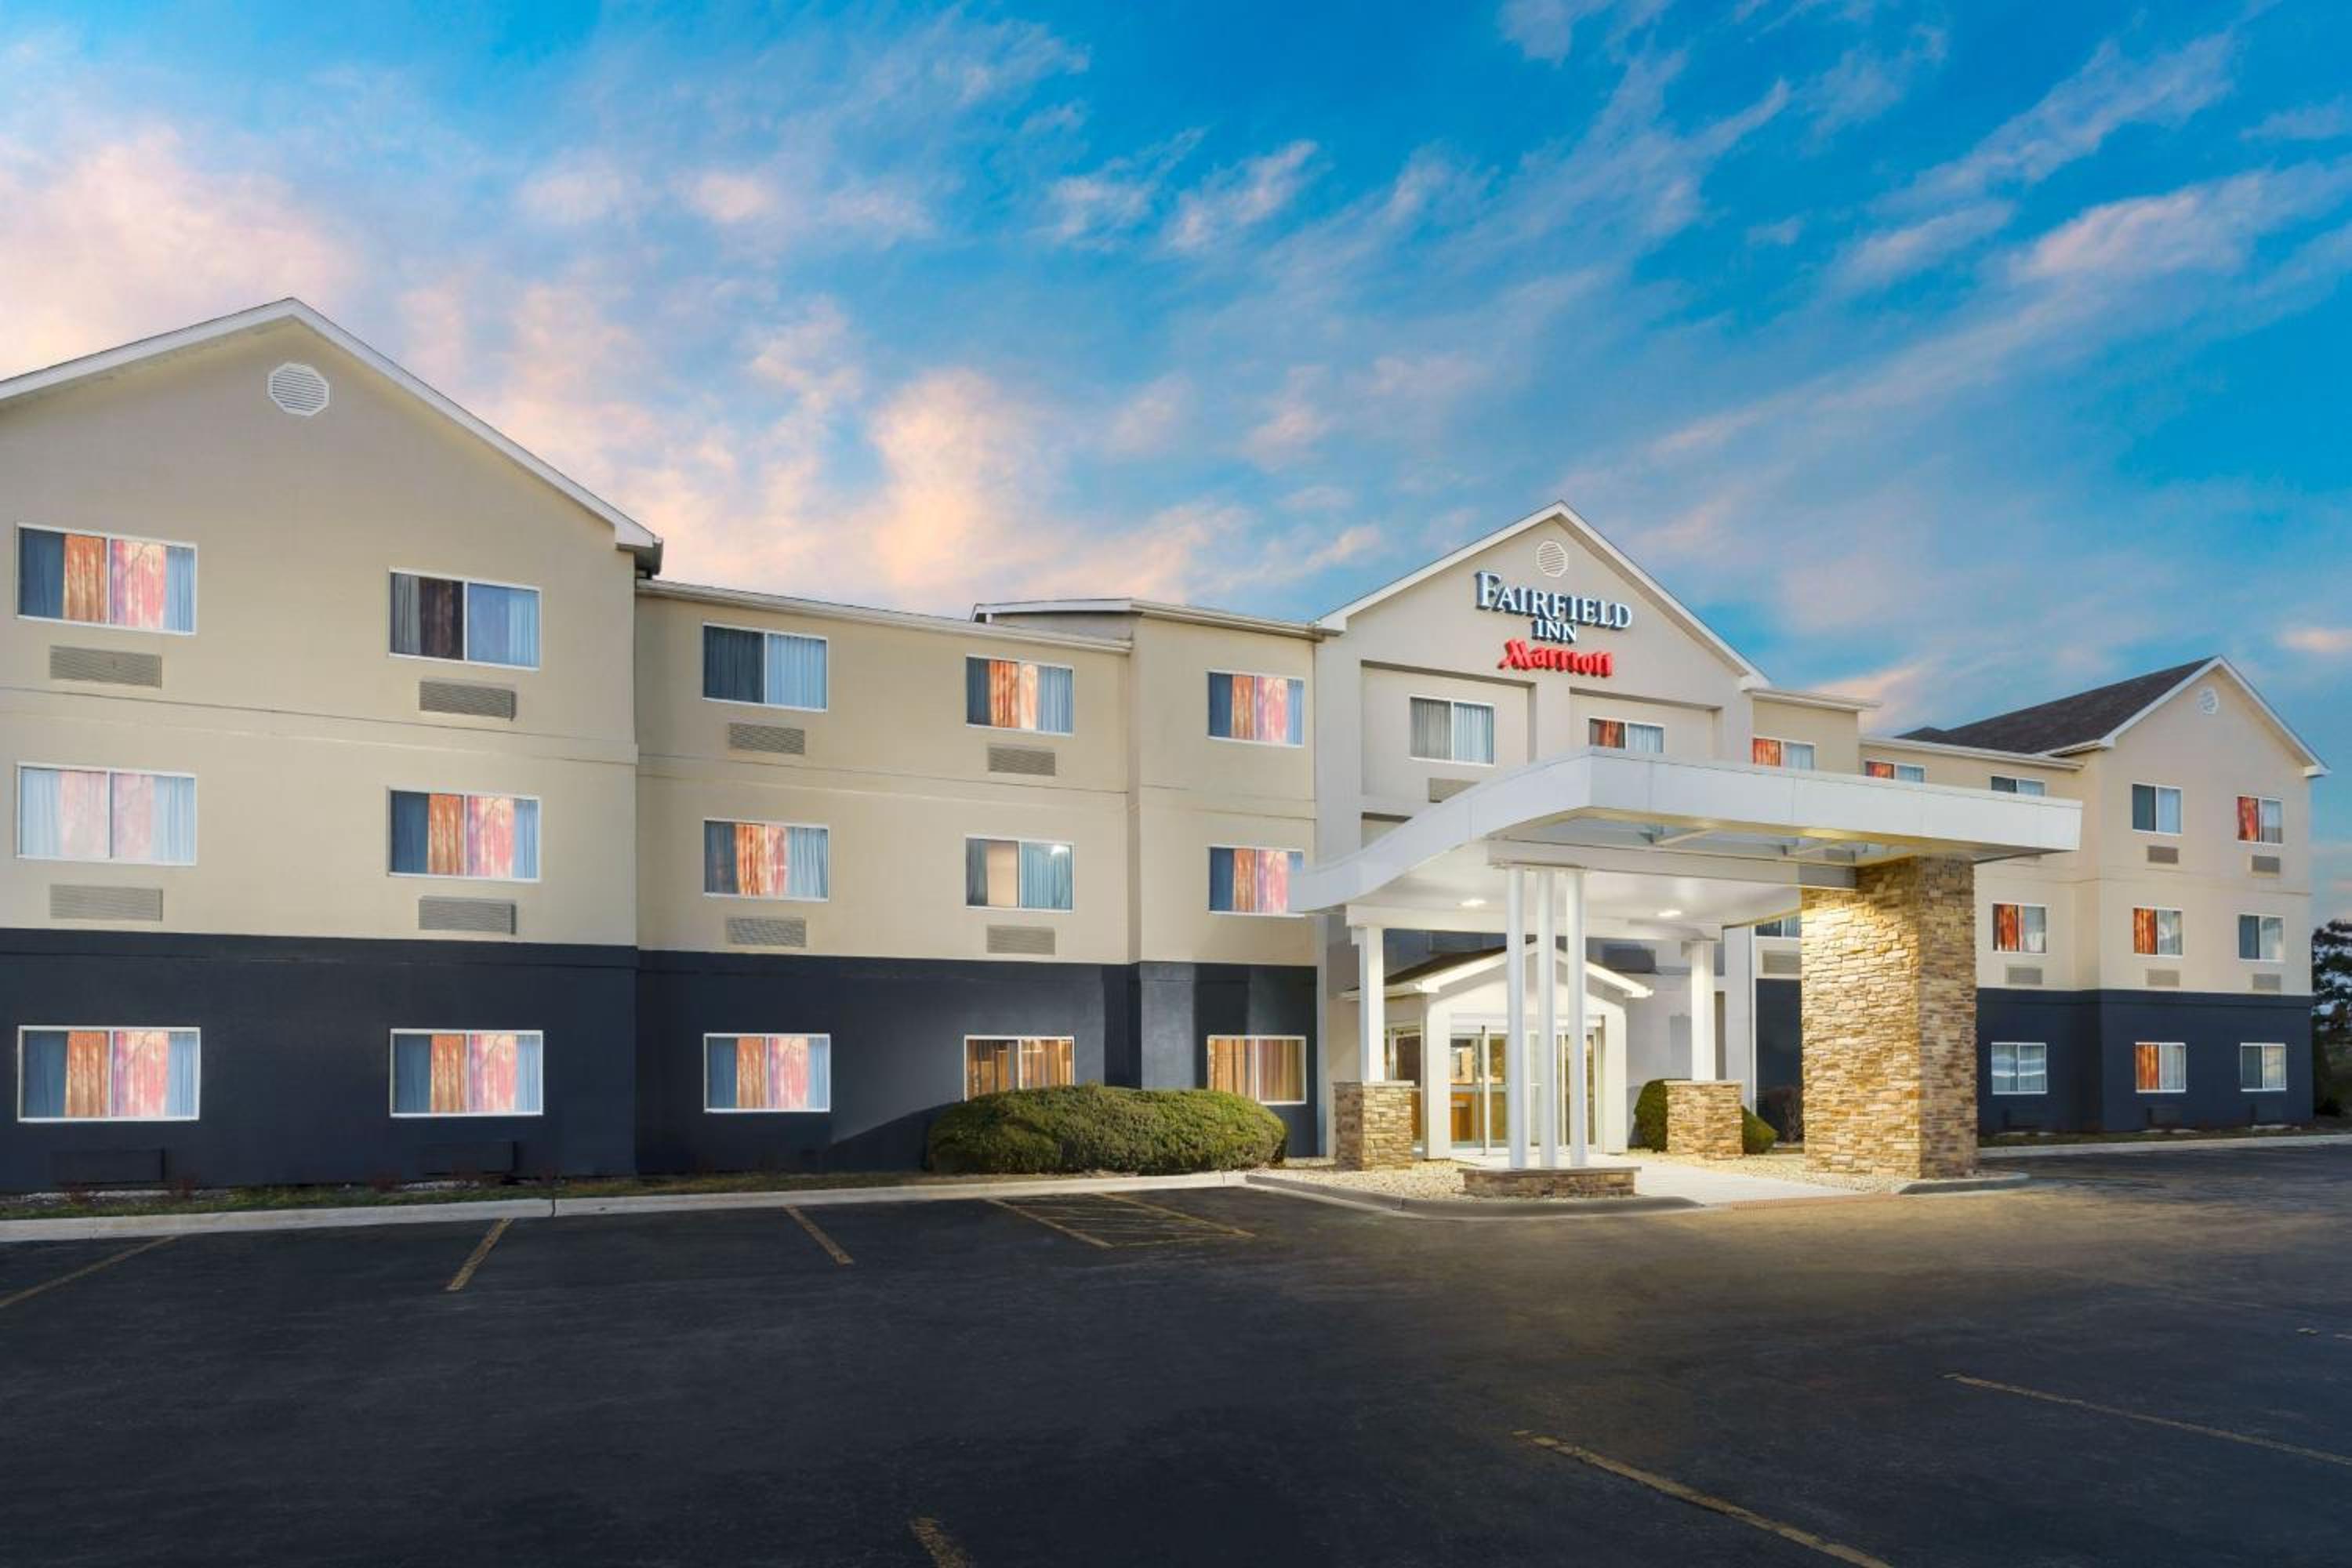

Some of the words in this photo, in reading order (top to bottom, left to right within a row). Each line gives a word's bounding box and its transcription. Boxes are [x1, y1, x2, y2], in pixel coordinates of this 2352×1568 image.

[1475, 571, 1632, 630] FAIRFIELD
[1532, 618, 1577, 644] INN
[1497, 639, 1613, 677] Marriott
